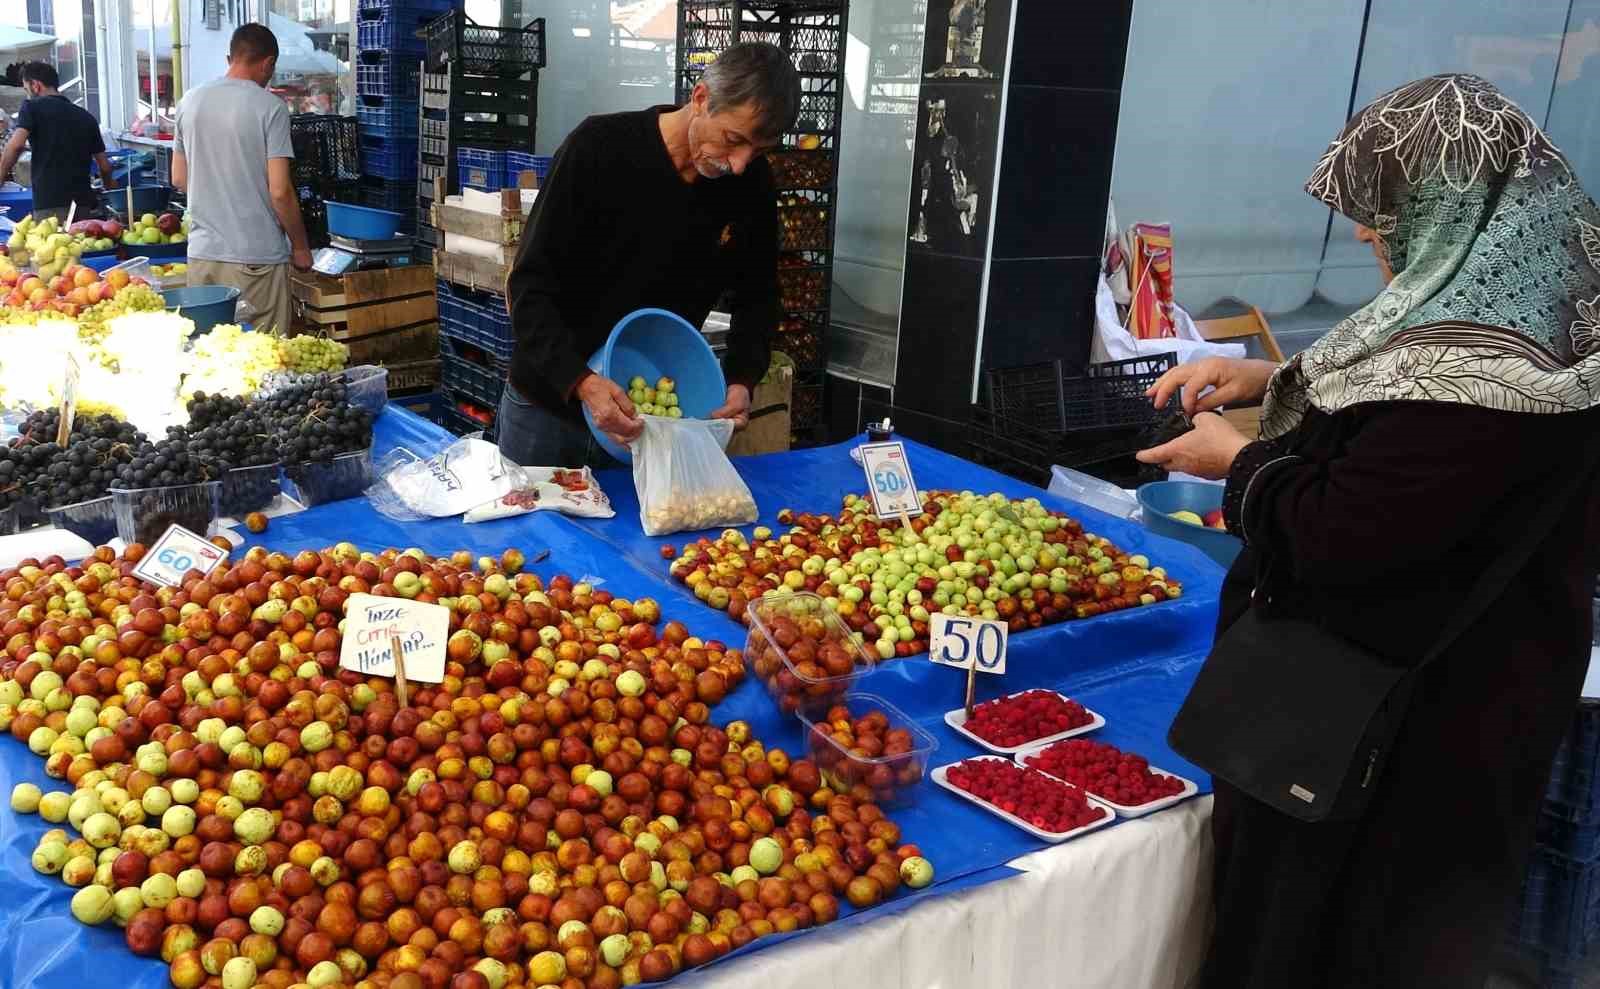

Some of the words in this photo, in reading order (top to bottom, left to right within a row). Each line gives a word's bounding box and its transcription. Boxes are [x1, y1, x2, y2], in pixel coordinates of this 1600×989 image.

[158, 548, 193, 571] 60
[364, 602, 409, 623] TAZE
[942, 620, 1003, 668] 50
